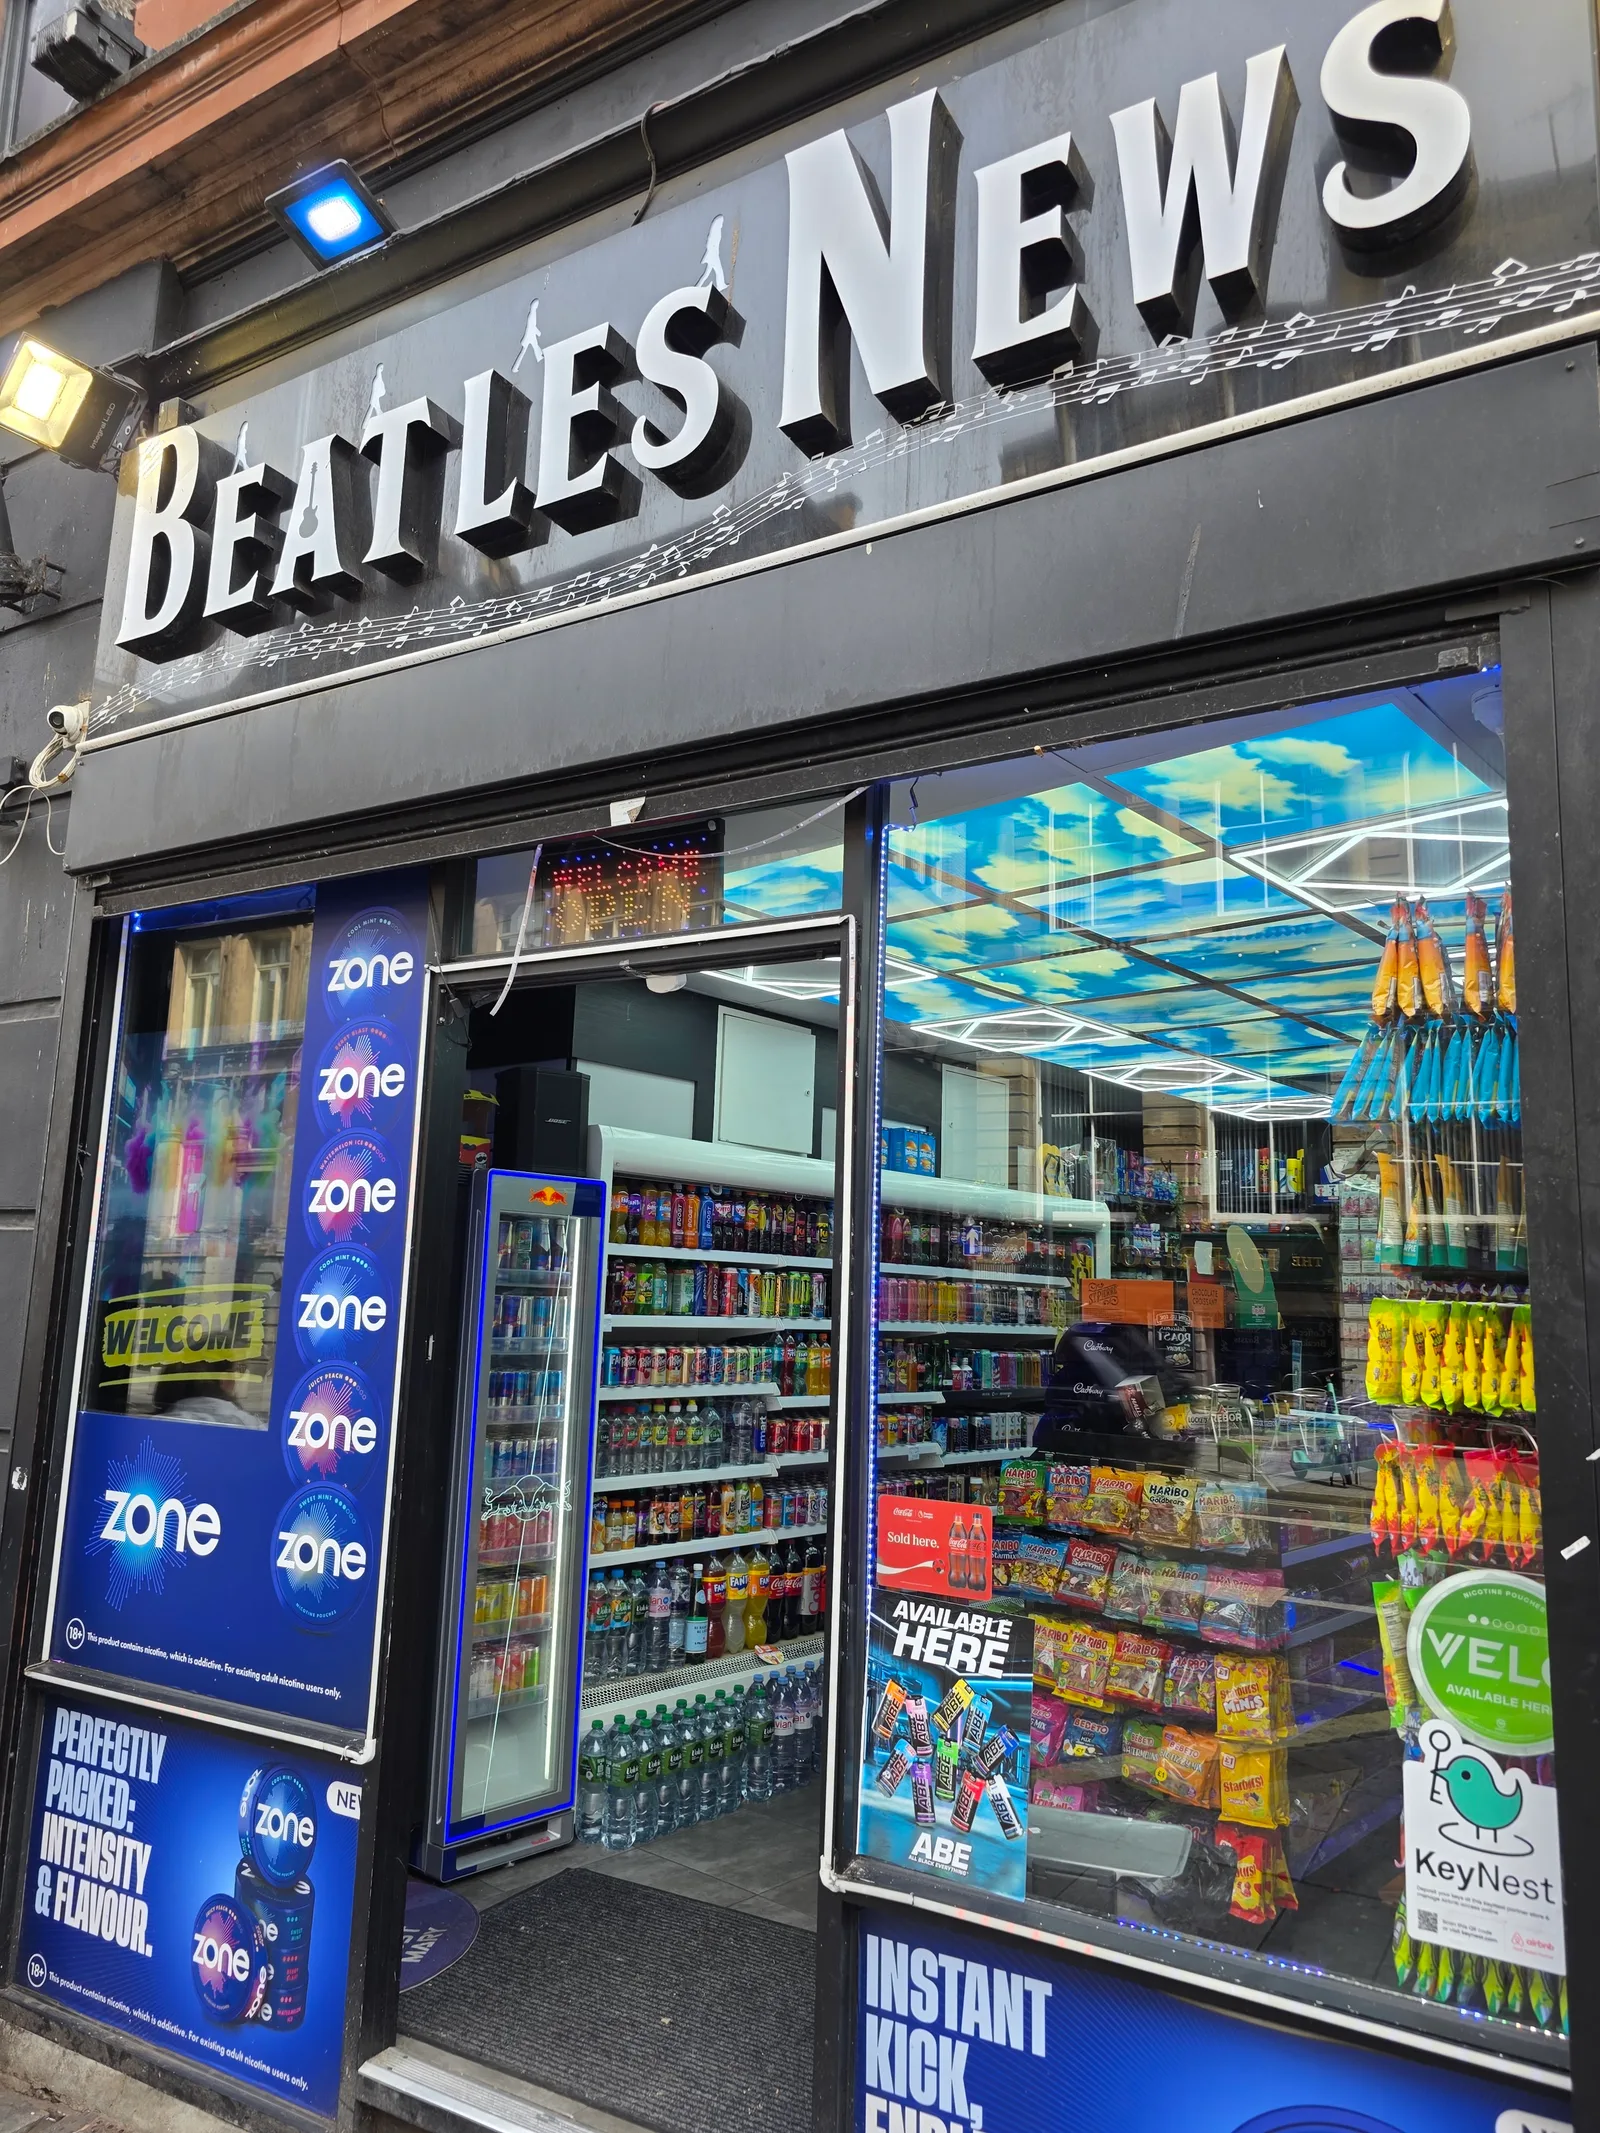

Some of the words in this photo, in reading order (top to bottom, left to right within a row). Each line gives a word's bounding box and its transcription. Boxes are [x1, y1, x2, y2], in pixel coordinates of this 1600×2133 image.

[114, 283, 724, 649] BEATLES
[780, 0, 1471, 430] NEWS
[90, 420, 107, 450] Integral
[106, 402, 116, 422] LED
[556, 884, 690, 933] OPEN
[347, 924, 361, 938] COOL
[328, 951, 414, 992] zone
[318, 1063, 405, 1101] zone
[320, 1139, 353, 1170] WATERMELON
[308, 1178, 396, 1213] zone
[319, 1259, 334, 1272] COOL
[334, 1254, 350, 1262] MINT
[1191, 1288, 1219, 1298] CHOCOLATE
[298, 1293, 387, 1332] zone
[106, 1311, 255, 1356] WELCOME
[1084, 1340, 1114, 1354] Cadbury
[308, 1375, 323, 1391] JUICY
[324, 1372, 344, 1380] PEACH
[1073, 1382, 1103, 1396] Cadbury
[287, 1411, 377, 1454] zone
[759, 1415, 767, 1448] smart
[1005, 1467, 1037, 1479] HARIBO
[1051, 1474, 1086, 1486] HARIBO
[1095, 1477, 1133, 1491] HARIBO
[298, 1494, 316, 1509] SWEET
[317, 1493, 333, 1501] MINT
[1149, 1484, 1189, 1498] HARIBO
[1149, 1496, 1185, 1506] Goldbears
[1200, 1494, 1236, 1506] HARIBO
[100, 1489, 221, 1556] zone
[276, 1531, 367, 1580] zone
[887, 1531, 911, 1545] Sold
[912, 1534, 940, 1549] here.
[1026, 1544, 1058, 1556] HARIBO
[1072, 1547, 1110, 1563] HARIBO
[1463, 1588, 1502, 1599] NICOTINE
[1506, 1591, 1546, 1613] POUCHES
[892, 1600, 1013, 1640] AVAILABLE
[1034, 1624, 1069, 1642] HARIBO
[892, 1621, 1010, 1679] HERE
[1073, 1632, 1108, 1650] HARIBO
[1122, 1641, 1160, 1656] HARIBO
[87, 1632, 98, 1643] This
[98, 1636, 120, 1647] product
[120, 1641, 144, 1653] contains
[144, 1646, 169, 1660] nicotine,
[169, 1651, 187, 1663] which
[187, 1655, 193, 1664] is
[194, 1657, 223, 1672] addictive.
[224, 1663, 235, 1674] For
[235, 1667, 260, 1682] existing
[261, 1672, 279, 1684] adult
[279, 1676, 305, 1690] nicotine
[305, 1683, 323, 1695] users
[324, 1687, 342, 1700] only.
[885, 1699, 901, 1730] ABE
[945, 1692, 965, 1724] ABE
[1446, 1684, 1518, 1708] AVAILABLE
[1522, 1700, 1552, 1715] HER
[915, 1711, 929, 1746] ABE
[970, 1707, 985, 1742] ABE
[1073, 1718, 1109, 1735] BEBETO
[51, 1706, 167, 1784] PERFECTLY
[983, 1736, 1005, 1765] ABE
[1170, 1741, 1200, 1758] BEBETO
[889, 1754, 908, 1784] ABE
[938, 1754, 951, 1787] ABE
[1157, 1769, 1166, 1778] £1
[45, 1758, 136, 1834] PACKED:
[918, 1776, 932, 1812] ABE
[956, 1783, 973, 1820] ABE
[992, 1791, 1014, 1825] ABE
[255, 1803, 315, 1847] zone
[40, 1811, 152, 1895] INTENSITY
[911, 1832, 972, 1871] ABE
[918, 1857, 935, 1867] BLACK
[1415, 1848, 1555, 1905] KeyNest
[34, 1865, 52, 1917] &
[53, 1870, 153, 1958] FLAVOUR.
[193, 1932, 250, 1982] zone
[401, 1927, 448, 1963] MARY
[1525, 1938, 1555, 1951] airbnb
[245, 1965, 267, 2019] zone
[866, 1933, 1053, 2058] INSTANT
[49, 1971, 60, 1984] This
[60, 1978, 82, 1993] product
[82, 1988, 106, 2004] contains
[106, 1997, 132, 2016] nicotine,
[133, 2009, 150, 2022] which
[151, 2014, 156, 2025] is
[157, 2018, 187, 2039] addictive.
[188, 2030, 199, 2043] For
[200, 2037, 225, 2057] existing
[226, 2048, 243, 2063] adult
[244, 2055, 271, 2074] nicotine
[271, 2067, 290, 2082] users
[291, 2076, 309, 2092] only.
[865, 2012, 983, 2130] KICK,
